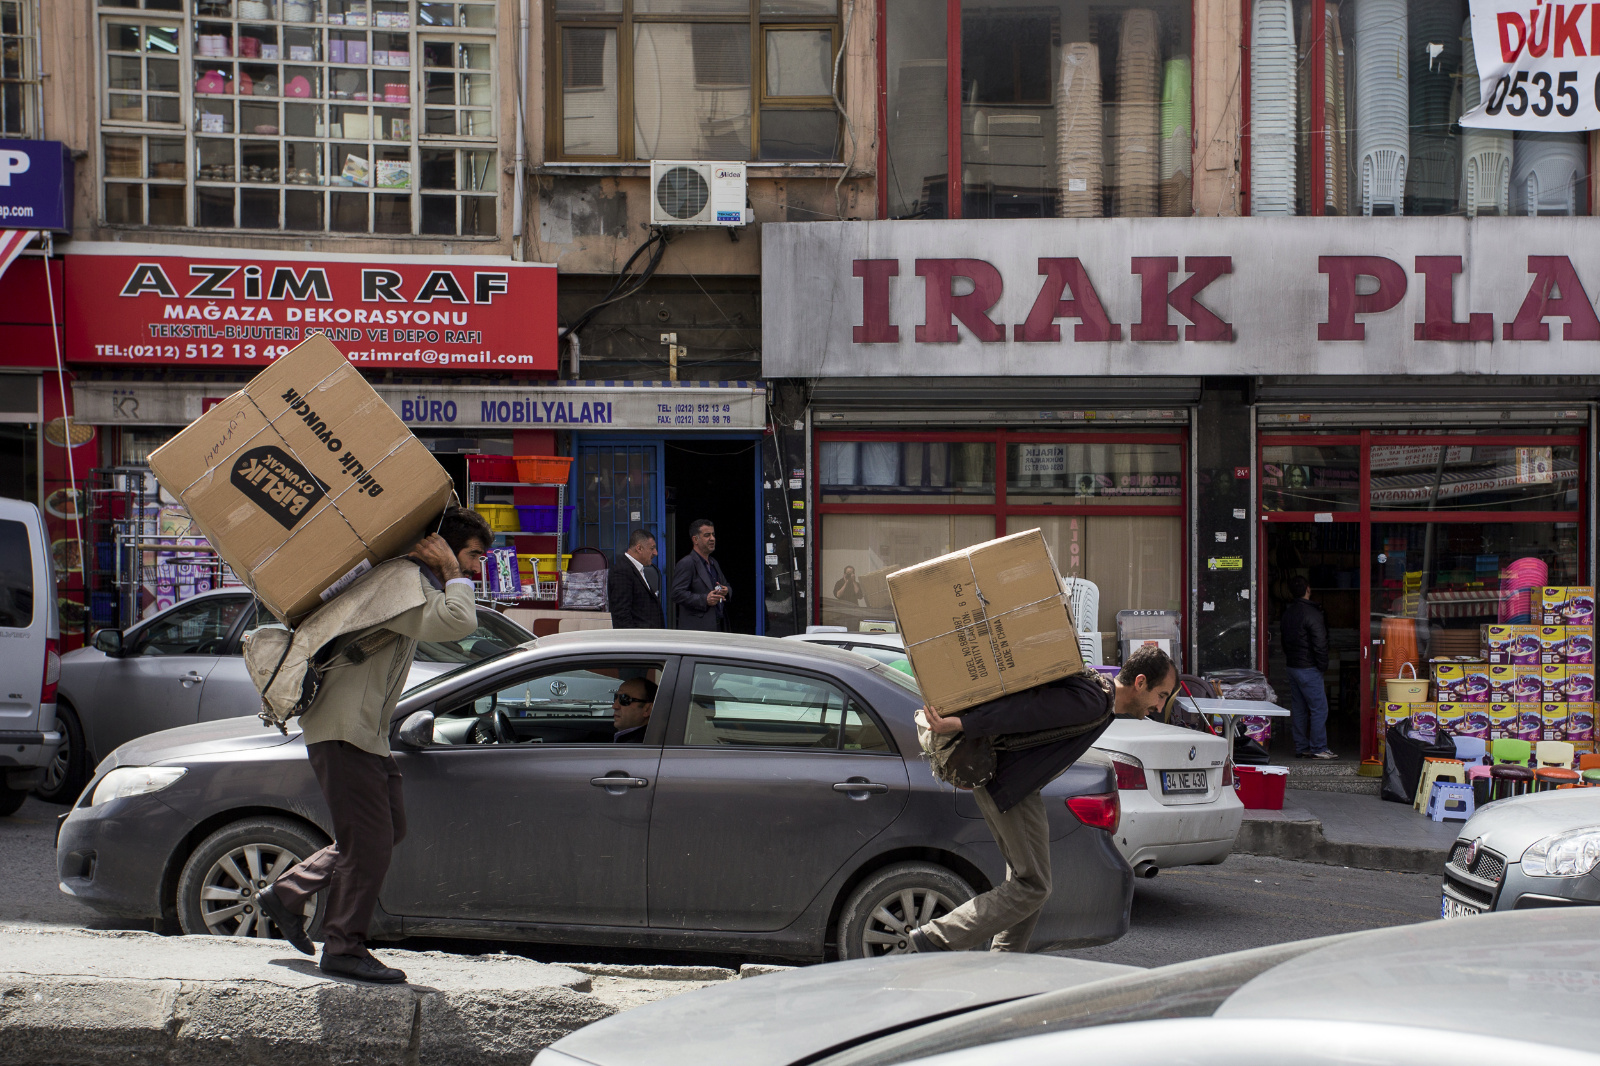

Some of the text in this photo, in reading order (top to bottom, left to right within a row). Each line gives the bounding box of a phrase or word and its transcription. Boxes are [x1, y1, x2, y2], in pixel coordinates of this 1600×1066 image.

[1485, 71, 1579, 117] 0535
[715, 169, 741, 179] Midea
[361, 268, 509, 305] RAF
[851, 255, 1600, 344] IRAK PLA
[163, 301, 468, 326] MAĞAZA DEKORASYONU
[366, 328, 388, 342] VE
[393, 330, 439, 343] DEPO
[445, 331, 482, 344] RAFI
[95, 344, 180, 359] TEL:(0212)
[185, 343, 224, 358] 512
[232, 344, 256, 358] 13
[347, 349, 534, 364] azimraf@gmail.com
[281, 387, 342, 452] OYUNCAK
[401, 396, 613, 424] BÜRO MOBİLYALARI
[657, 404, 730, 414] TEL: (0212) 512 13 49
[657, 416, 671, 424] FAX:
[675, 416, 694, 425] (0212)
[698, 416, 709, 424] 520
[722, 416, 731, 424] 78
[261, 454, 315, 494] OYUNCAK
[953, 583, 964, 598] PCS
[993, 618, 1006, 640] CHINA
[1002, 648, 1016, 669] MADE
[965, 660, 979, 681] MODEL
[1166, 772, 1206, 789] 34 NE 430
